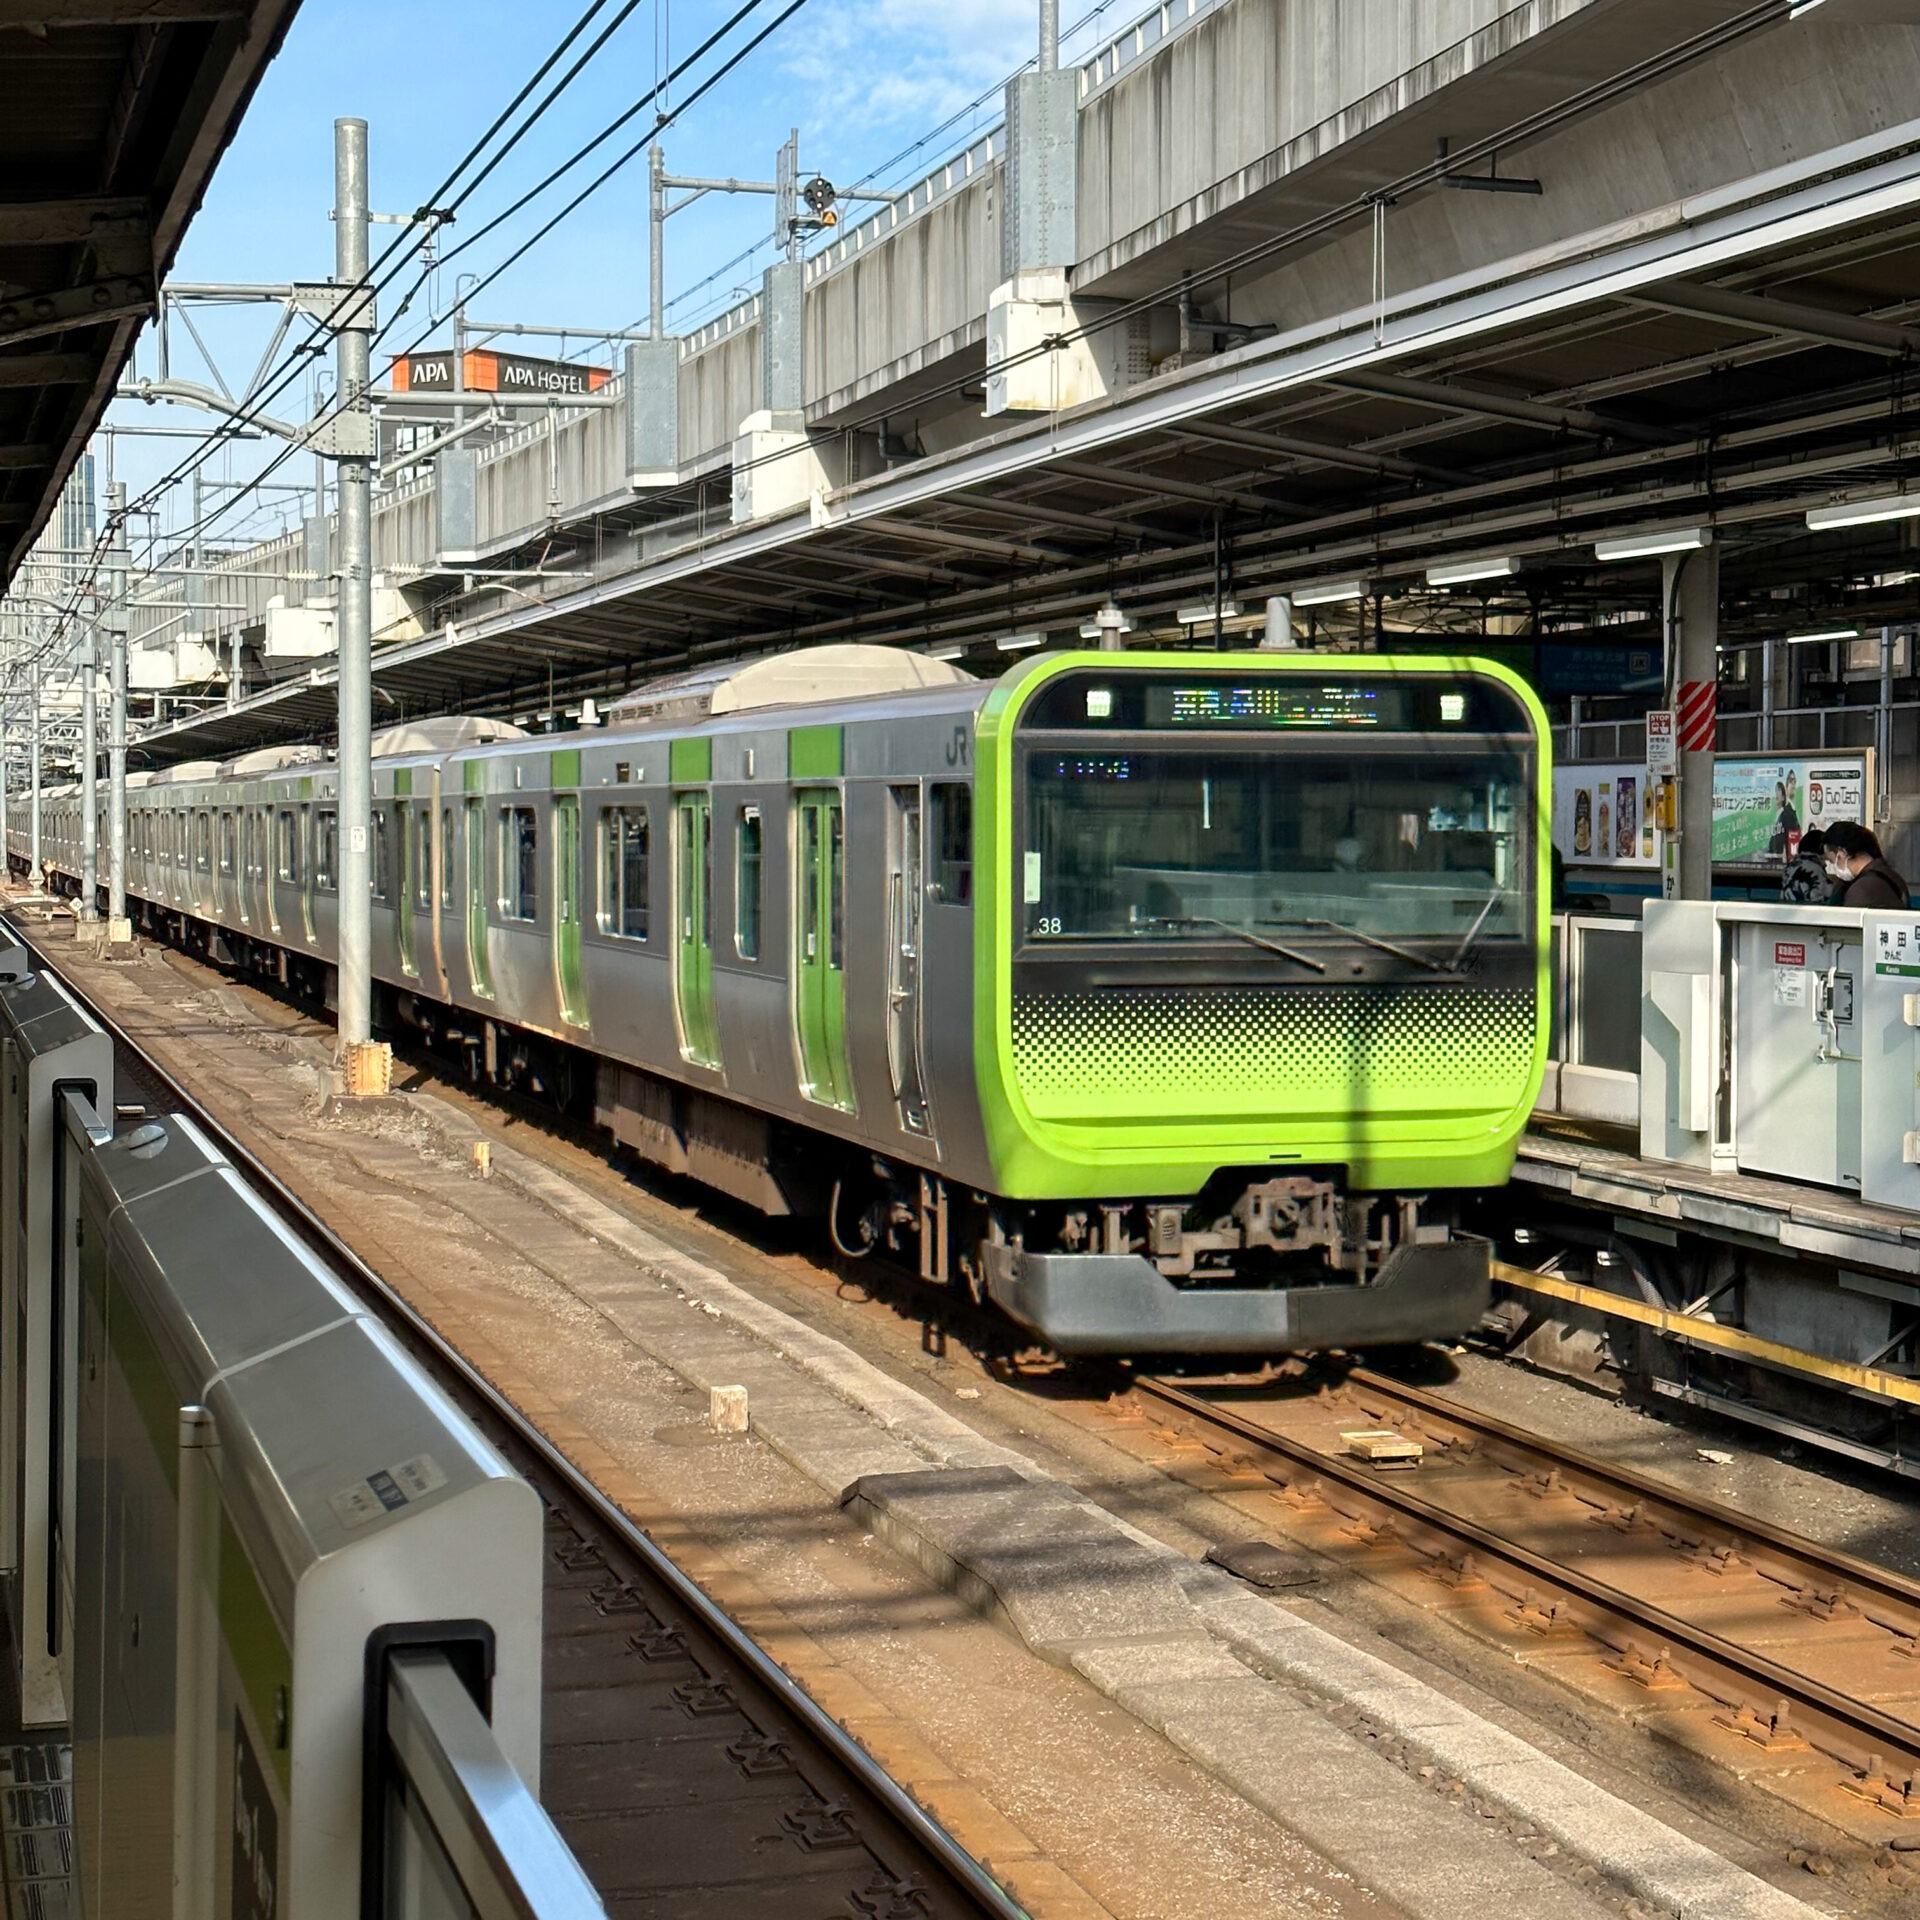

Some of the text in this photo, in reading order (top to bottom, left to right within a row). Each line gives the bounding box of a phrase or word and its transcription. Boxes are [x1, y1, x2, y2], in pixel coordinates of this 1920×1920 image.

[412, 362, 449, 384] APA
[504, 366, 586, 394] APA HOTEL
[946, 726, 967, 767] JR
[1038, 917, 1062, 934] 38
[1880, 929, 1907, 947] 神田
[1884, 950, 1902, 961] かんだ
